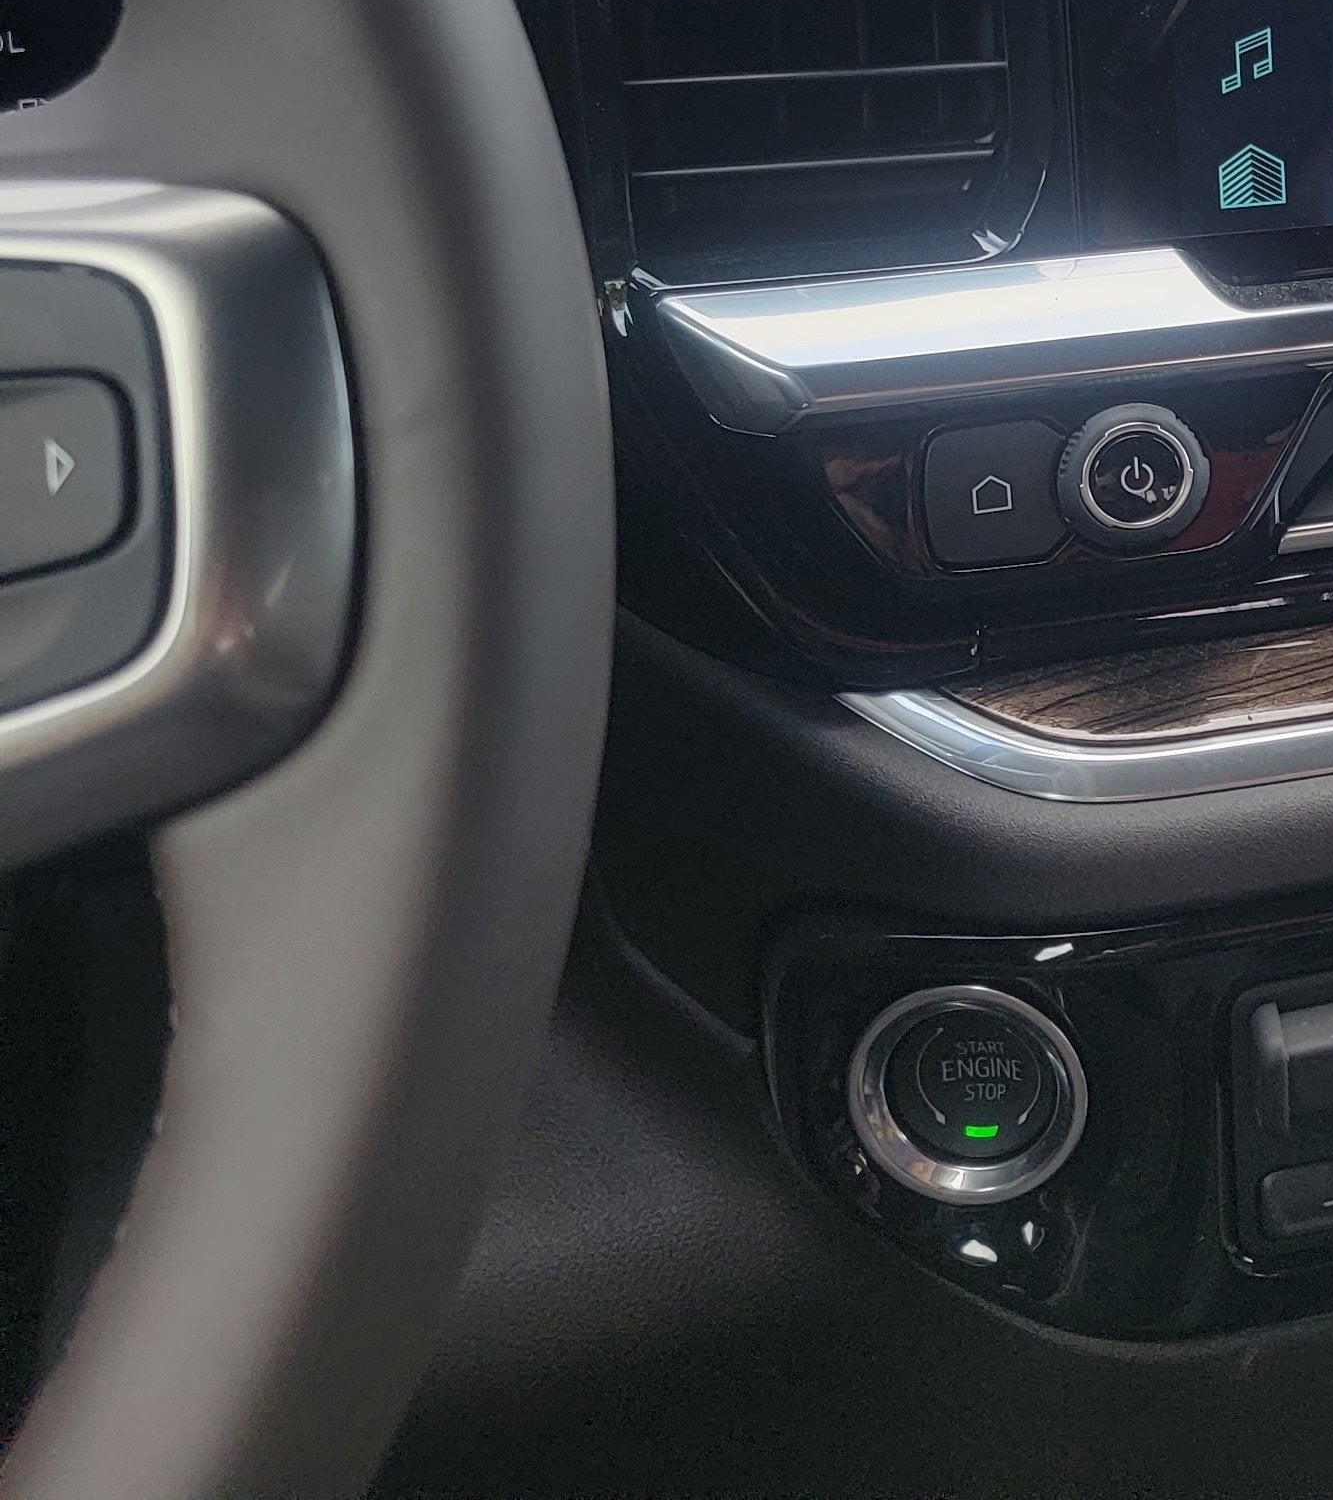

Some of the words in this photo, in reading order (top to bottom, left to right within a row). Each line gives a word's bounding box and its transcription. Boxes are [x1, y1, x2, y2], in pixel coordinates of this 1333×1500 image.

[956, 1041, 1005, 1055] START
[941, 1058, 1023, 1082] ENGINE
[964, 1083, 1007, 1101] STOP
